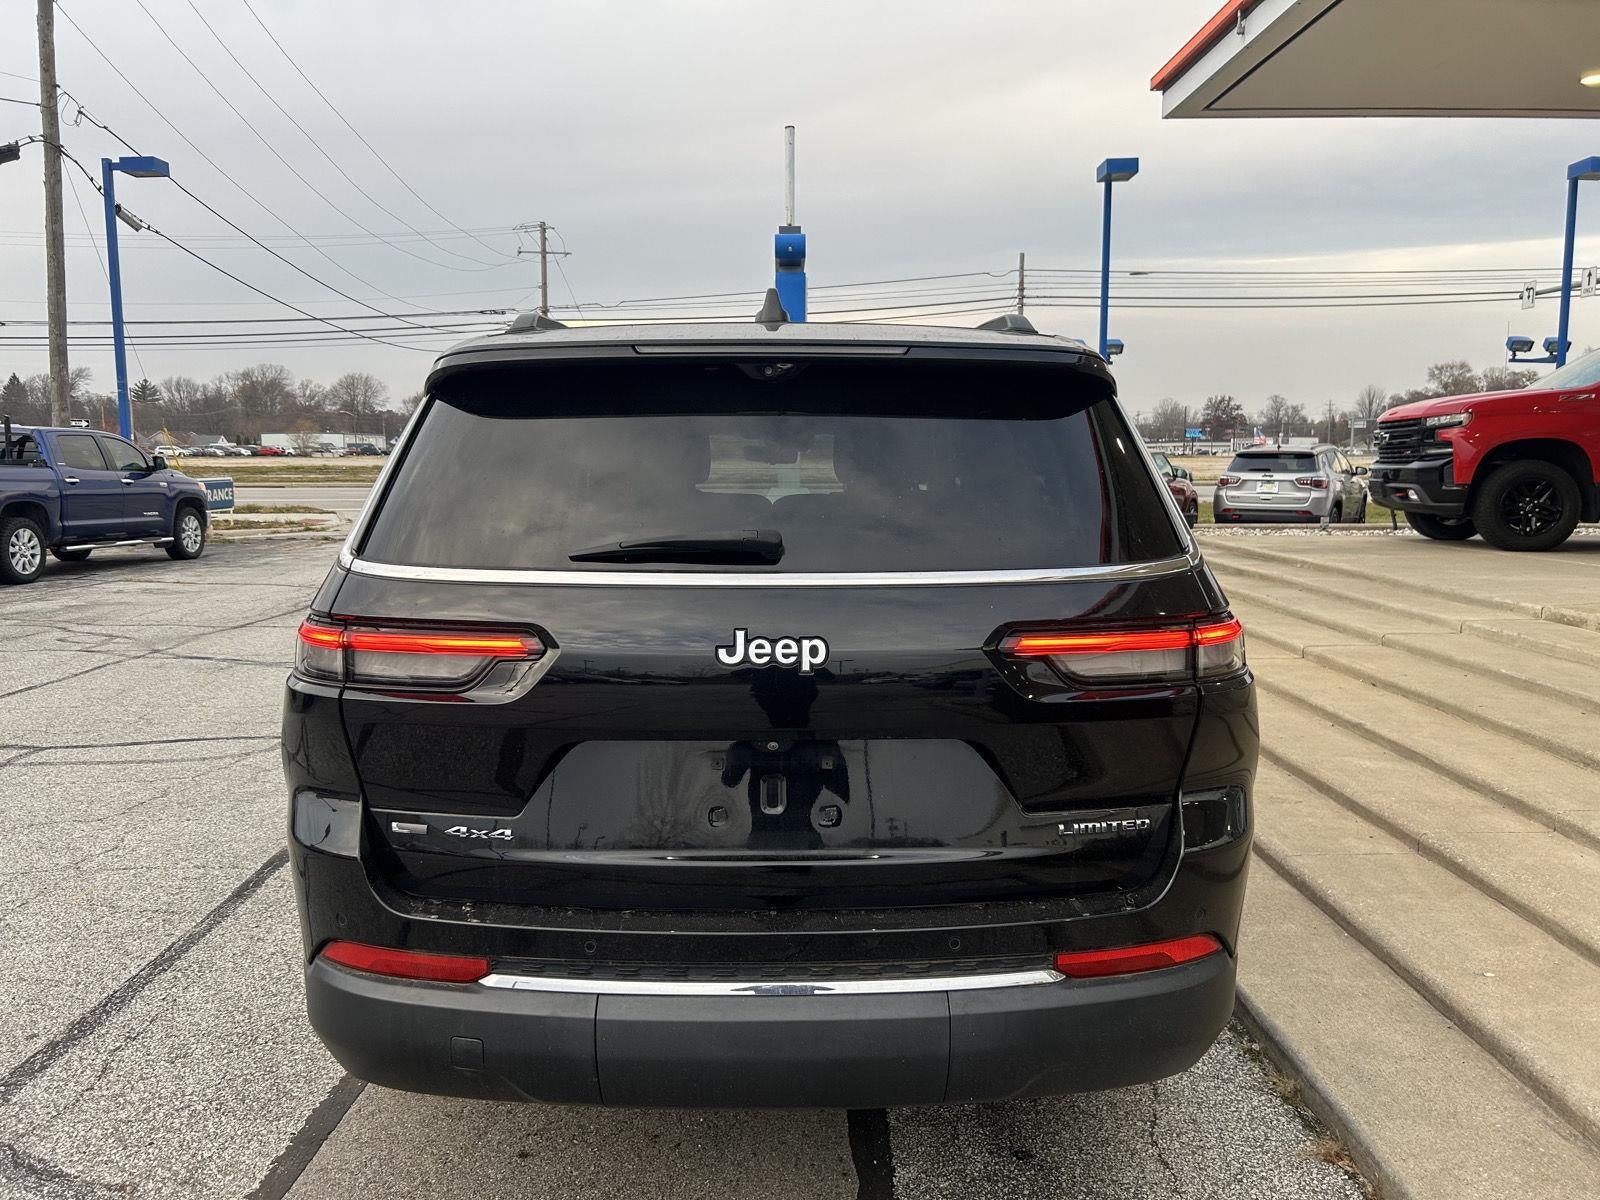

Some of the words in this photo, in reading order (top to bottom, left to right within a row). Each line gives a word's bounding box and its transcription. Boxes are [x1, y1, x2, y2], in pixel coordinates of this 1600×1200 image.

[717, 628, 828, 673] Jeep
[444, 825, 514, 840] 4x4
[1058, 818, 1150, 836] LIMITED
